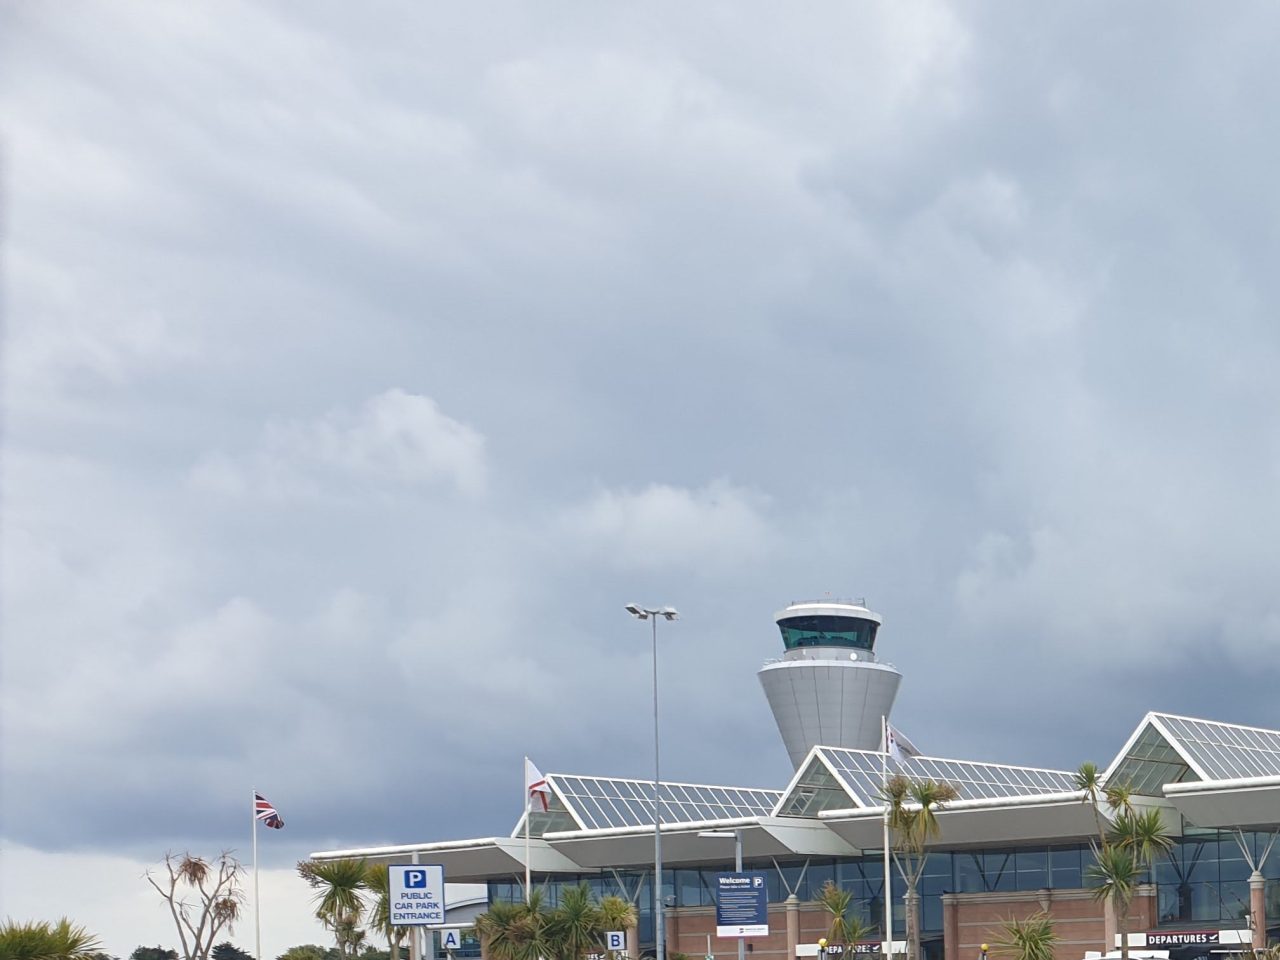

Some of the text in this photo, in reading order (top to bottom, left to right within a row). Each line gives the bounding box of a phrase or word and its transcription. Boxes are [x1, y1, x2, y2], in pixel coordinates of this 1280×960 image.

[409, 872, 422, 887] P
[400, 892, 433, 900] PUBLIC
[394, 902, 440, 910] CAR PARK
[393, 912, 442, 920] ENTRANCE
[445, 932, 456, 946] A
[610, 934, 620, 947] B
[1149, 934, 1207, 944] DEPARTURES
